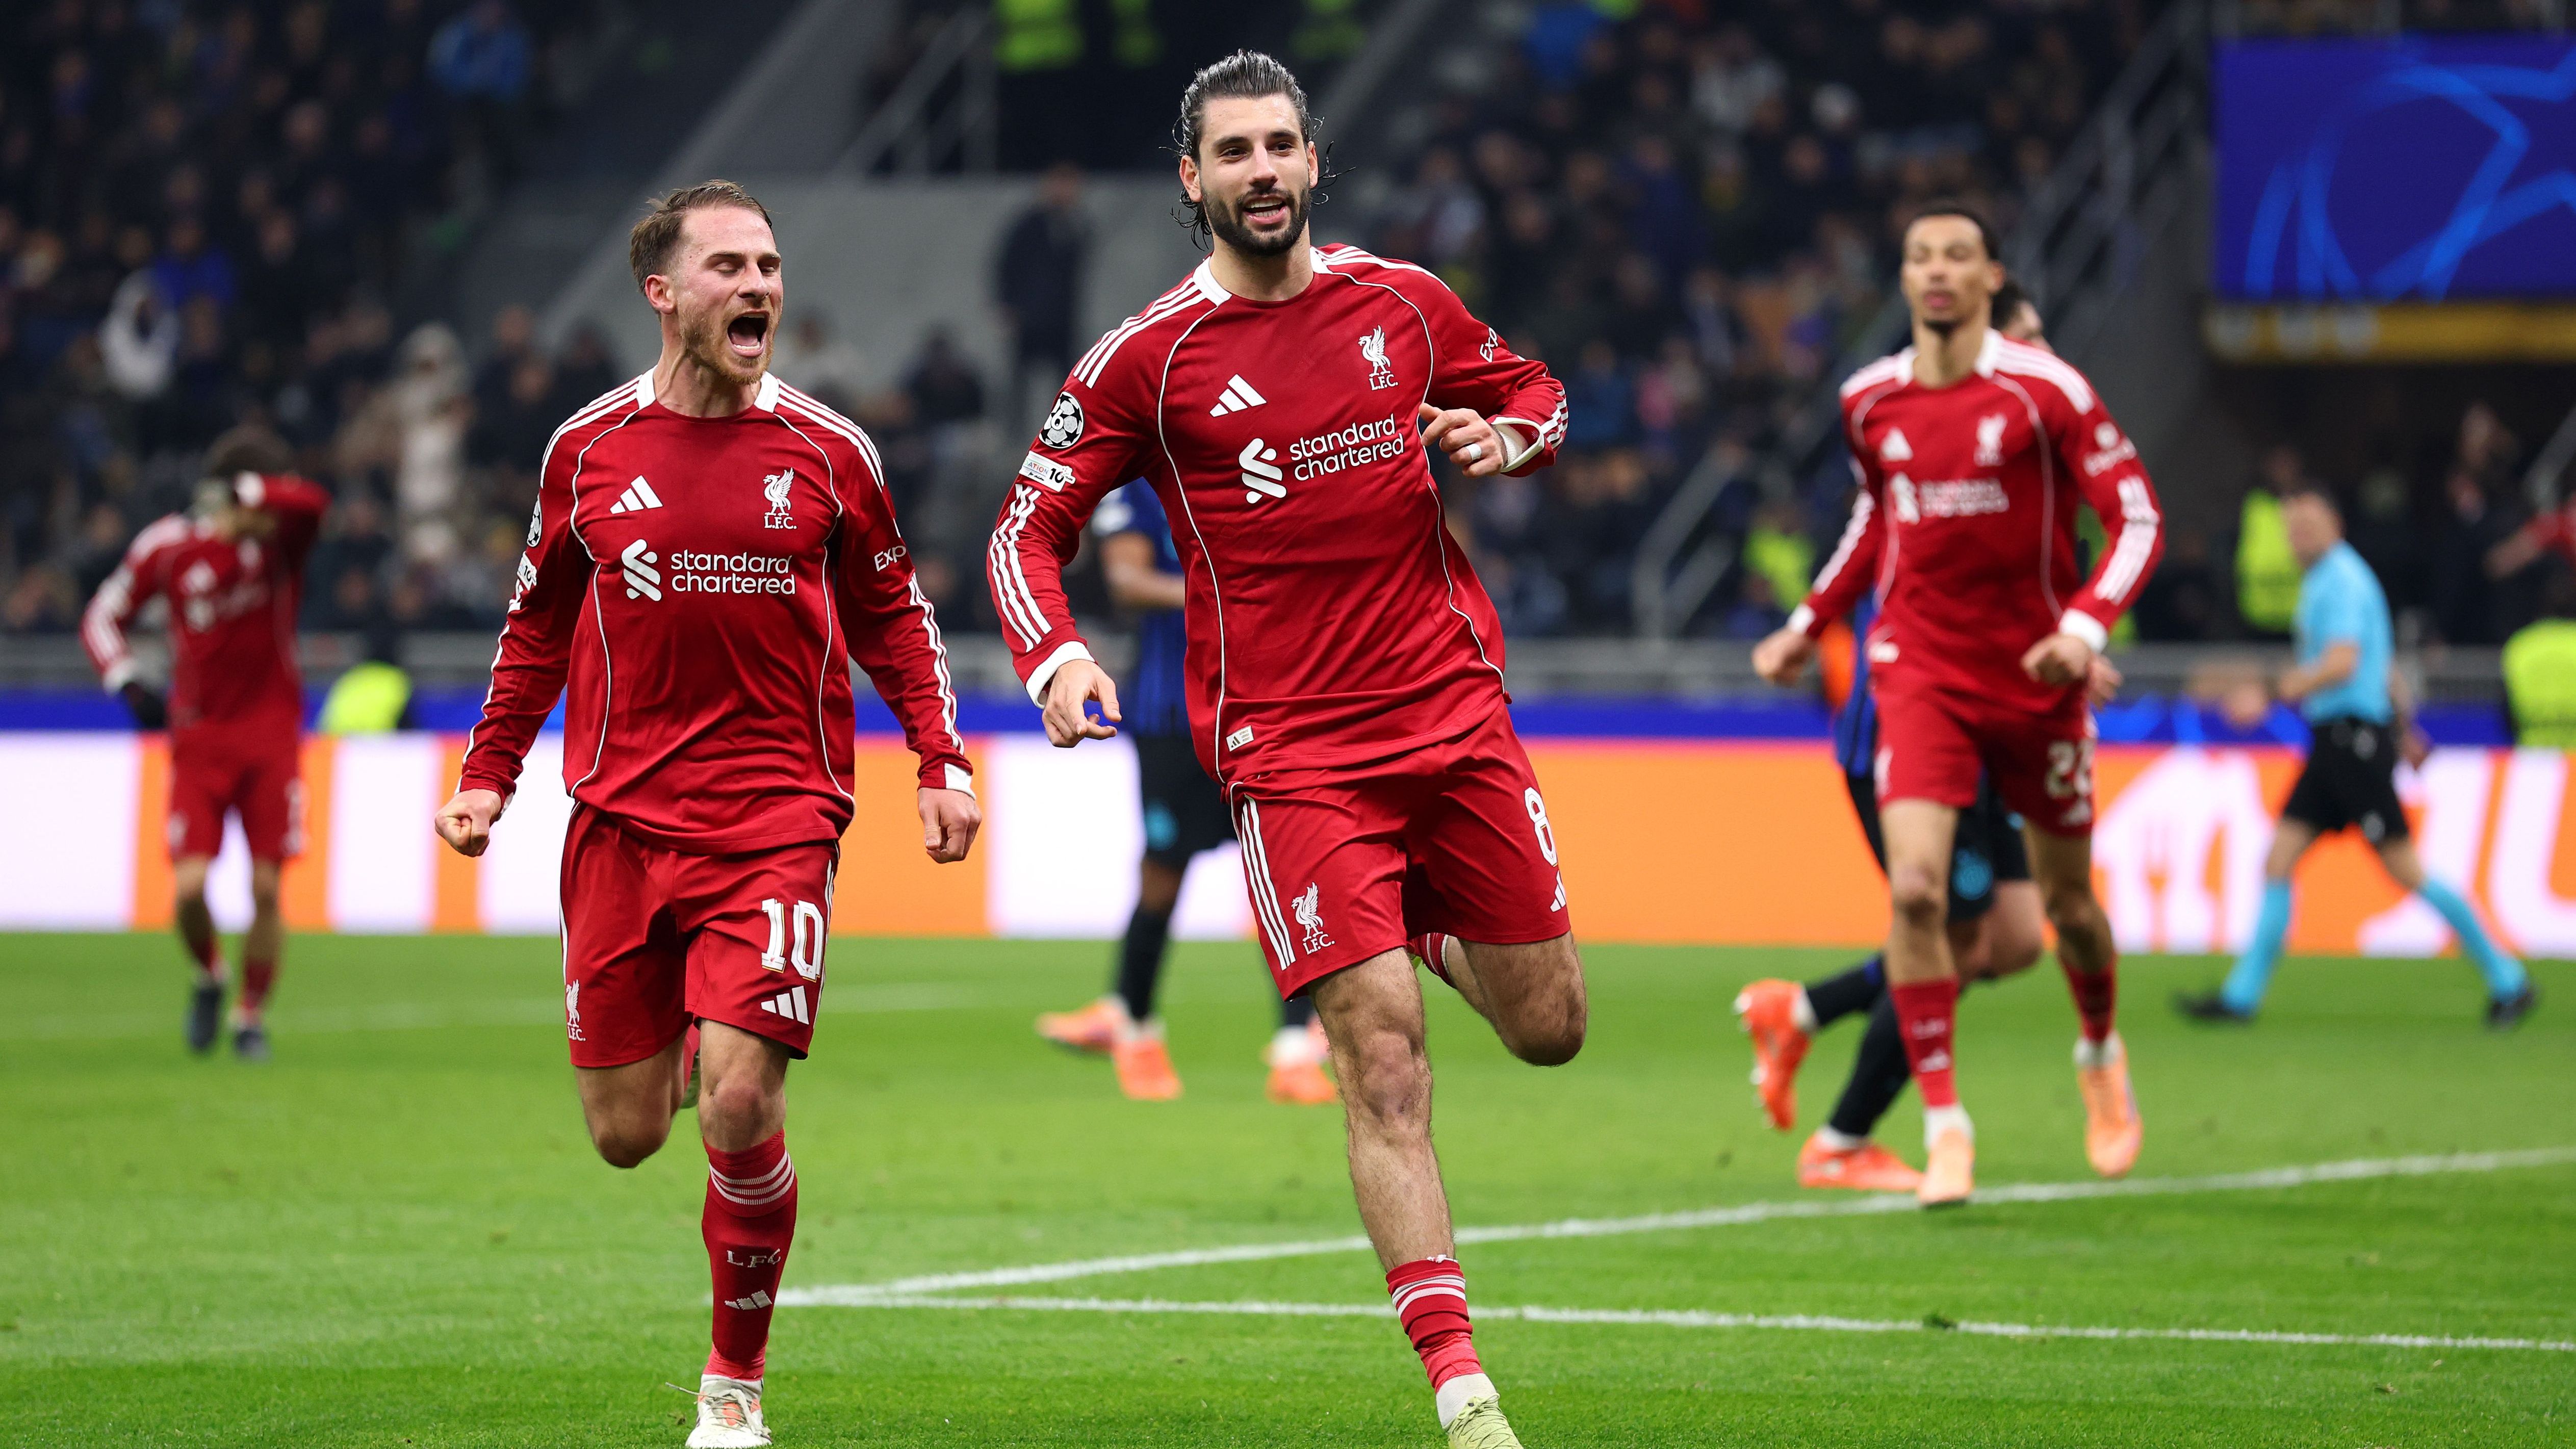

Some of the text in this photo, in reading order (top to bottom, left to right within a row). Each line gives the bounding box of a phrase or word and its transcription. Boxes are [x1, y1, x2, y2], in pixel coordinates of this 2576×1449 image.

[1480, 327, 1499, 363] Exp
[1369, 374, 1399, 391] L.F.C.
[1050, 408, 1064, 430] 6
[1290, 413, 1396, 460] standard
[1294, 432, 1404, 481] chartered
[764, 516, 797, 529] L.F.C.
[671, 549, 792, 574] standard
[874, 546, 907, 572] Exp
[672, 571, 795, 594] chartered
[1524, 787, 1558, 867] 8
[761, 897, 824, 982] 10
[1302, 933, 1335, 955] L.F.C.
[727, 1248, 781, 1268] LFC
